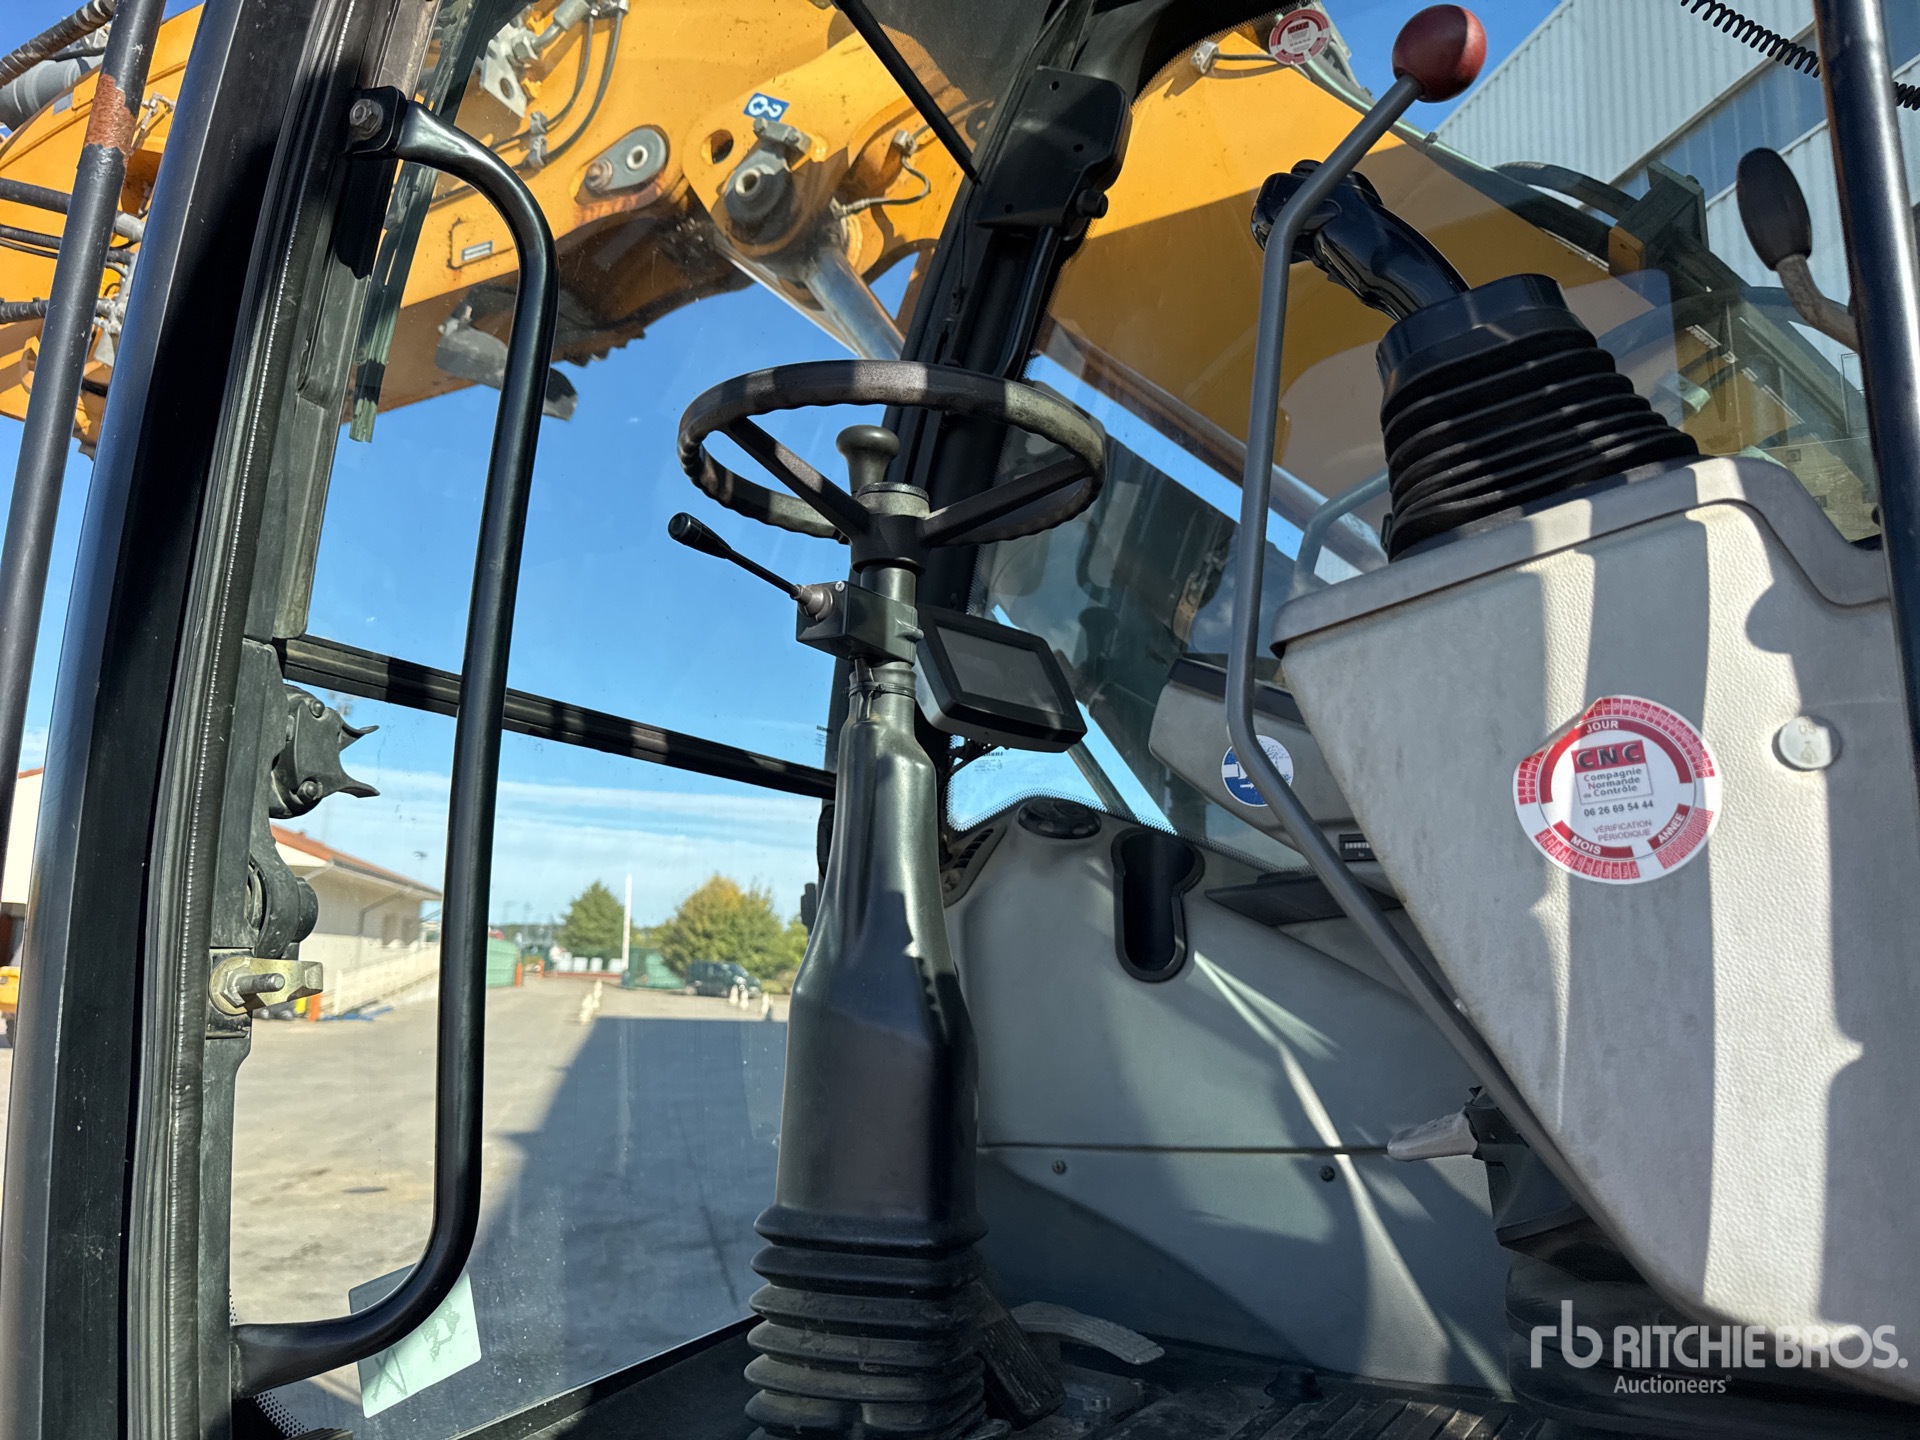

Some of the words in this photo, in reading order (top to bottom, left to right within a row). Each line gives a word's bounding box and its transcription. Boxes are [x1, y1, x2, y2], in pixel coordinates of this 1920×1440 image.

[1586, 720, 1619, 734] JOUR
[1576, 743, 1641, 769] CNC
[1583, 767, 1642, 782] Compagnie
[1588, 776, 1641, 790] Normande
[1593, 784, 1638, 797] Contrôle
[1584, 807, 1596, 817] 06
[1598, 805, 1610, 815] 26
[1612, 803, 1625, 813] 69
[1627, 801, 1639, 811] 54
[1641, 799, 1654, 809] 44
[1571, 835, 1601, 855] MOIS
